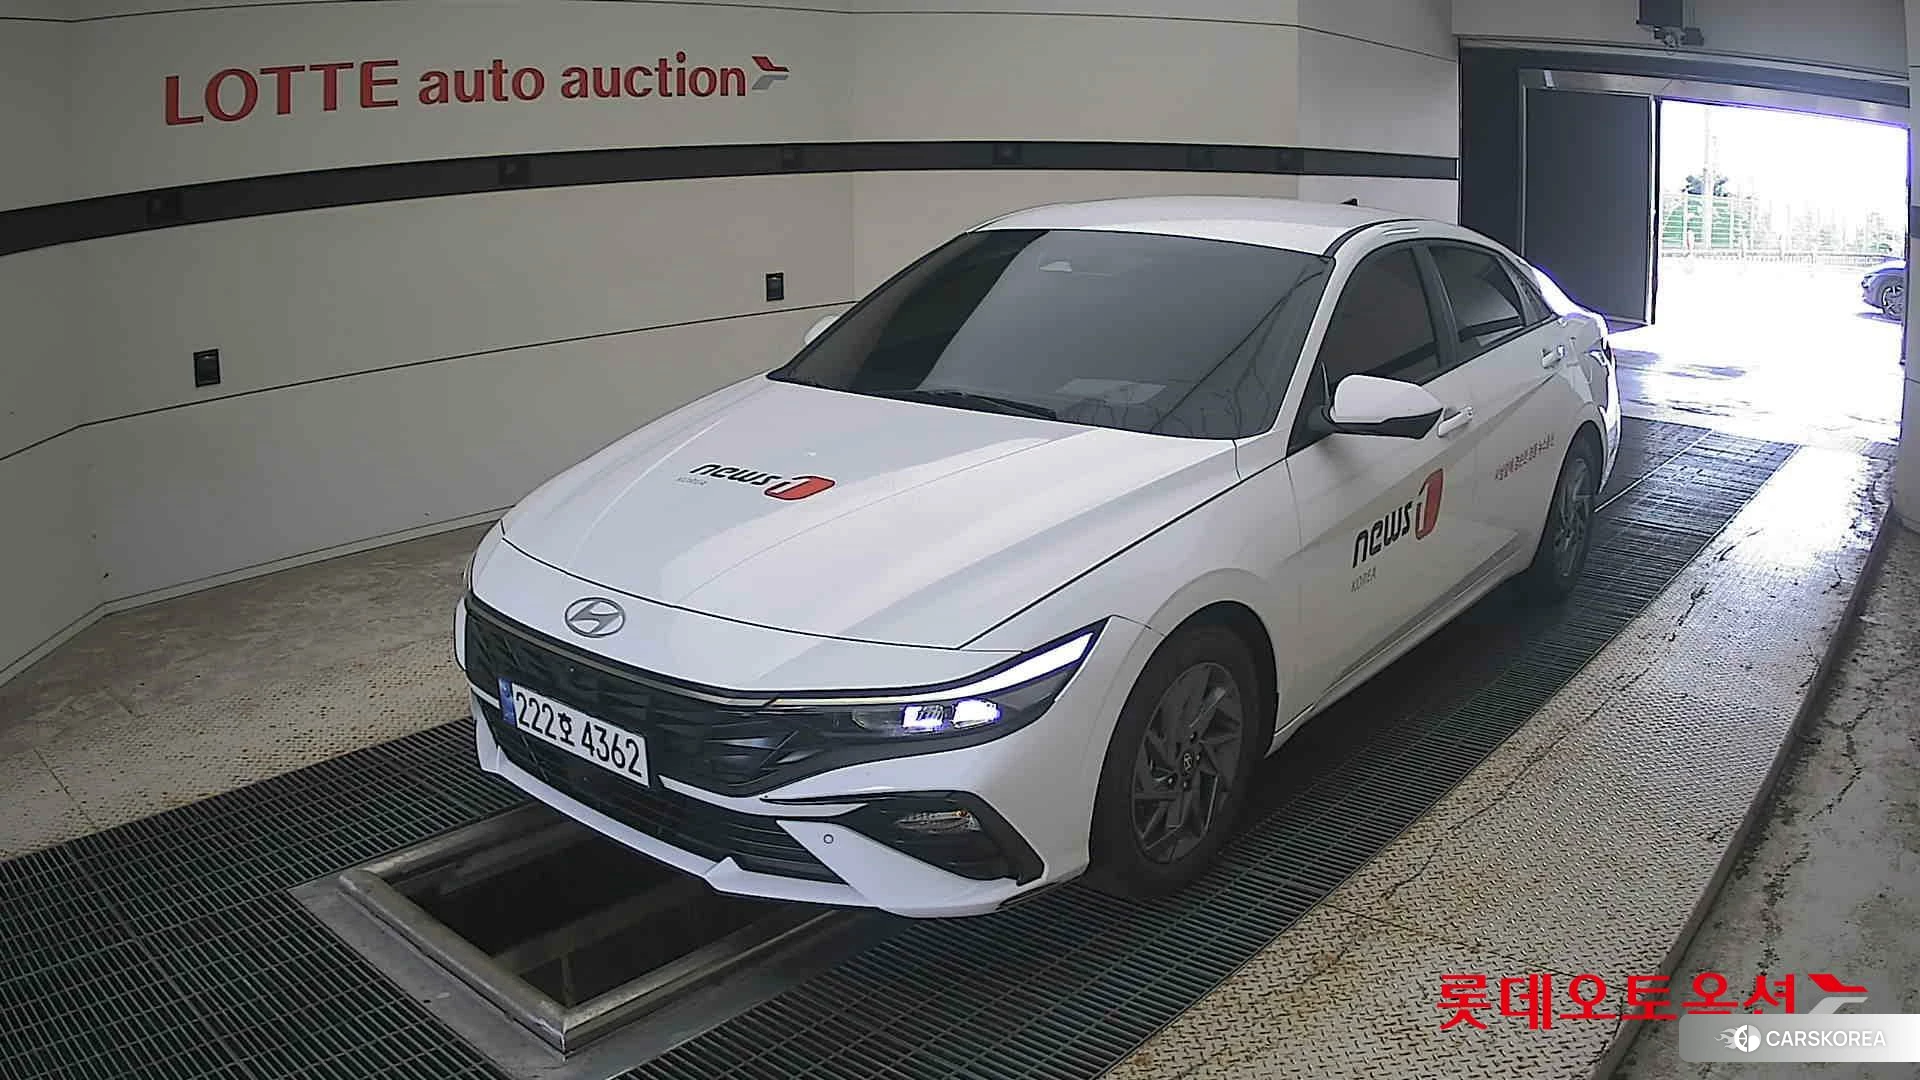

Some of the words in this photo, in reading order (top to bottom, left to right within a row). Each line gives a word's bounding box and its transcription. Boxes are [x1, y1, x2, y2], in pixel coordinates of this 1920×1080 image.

[165, 59, 399, 126] LOTTE
[418, 59, 545, 105] auto
[560, 51, 747, 98] auction
[516, 691, 575, 747] 222호
[581, 721, 642, 778] 4362
